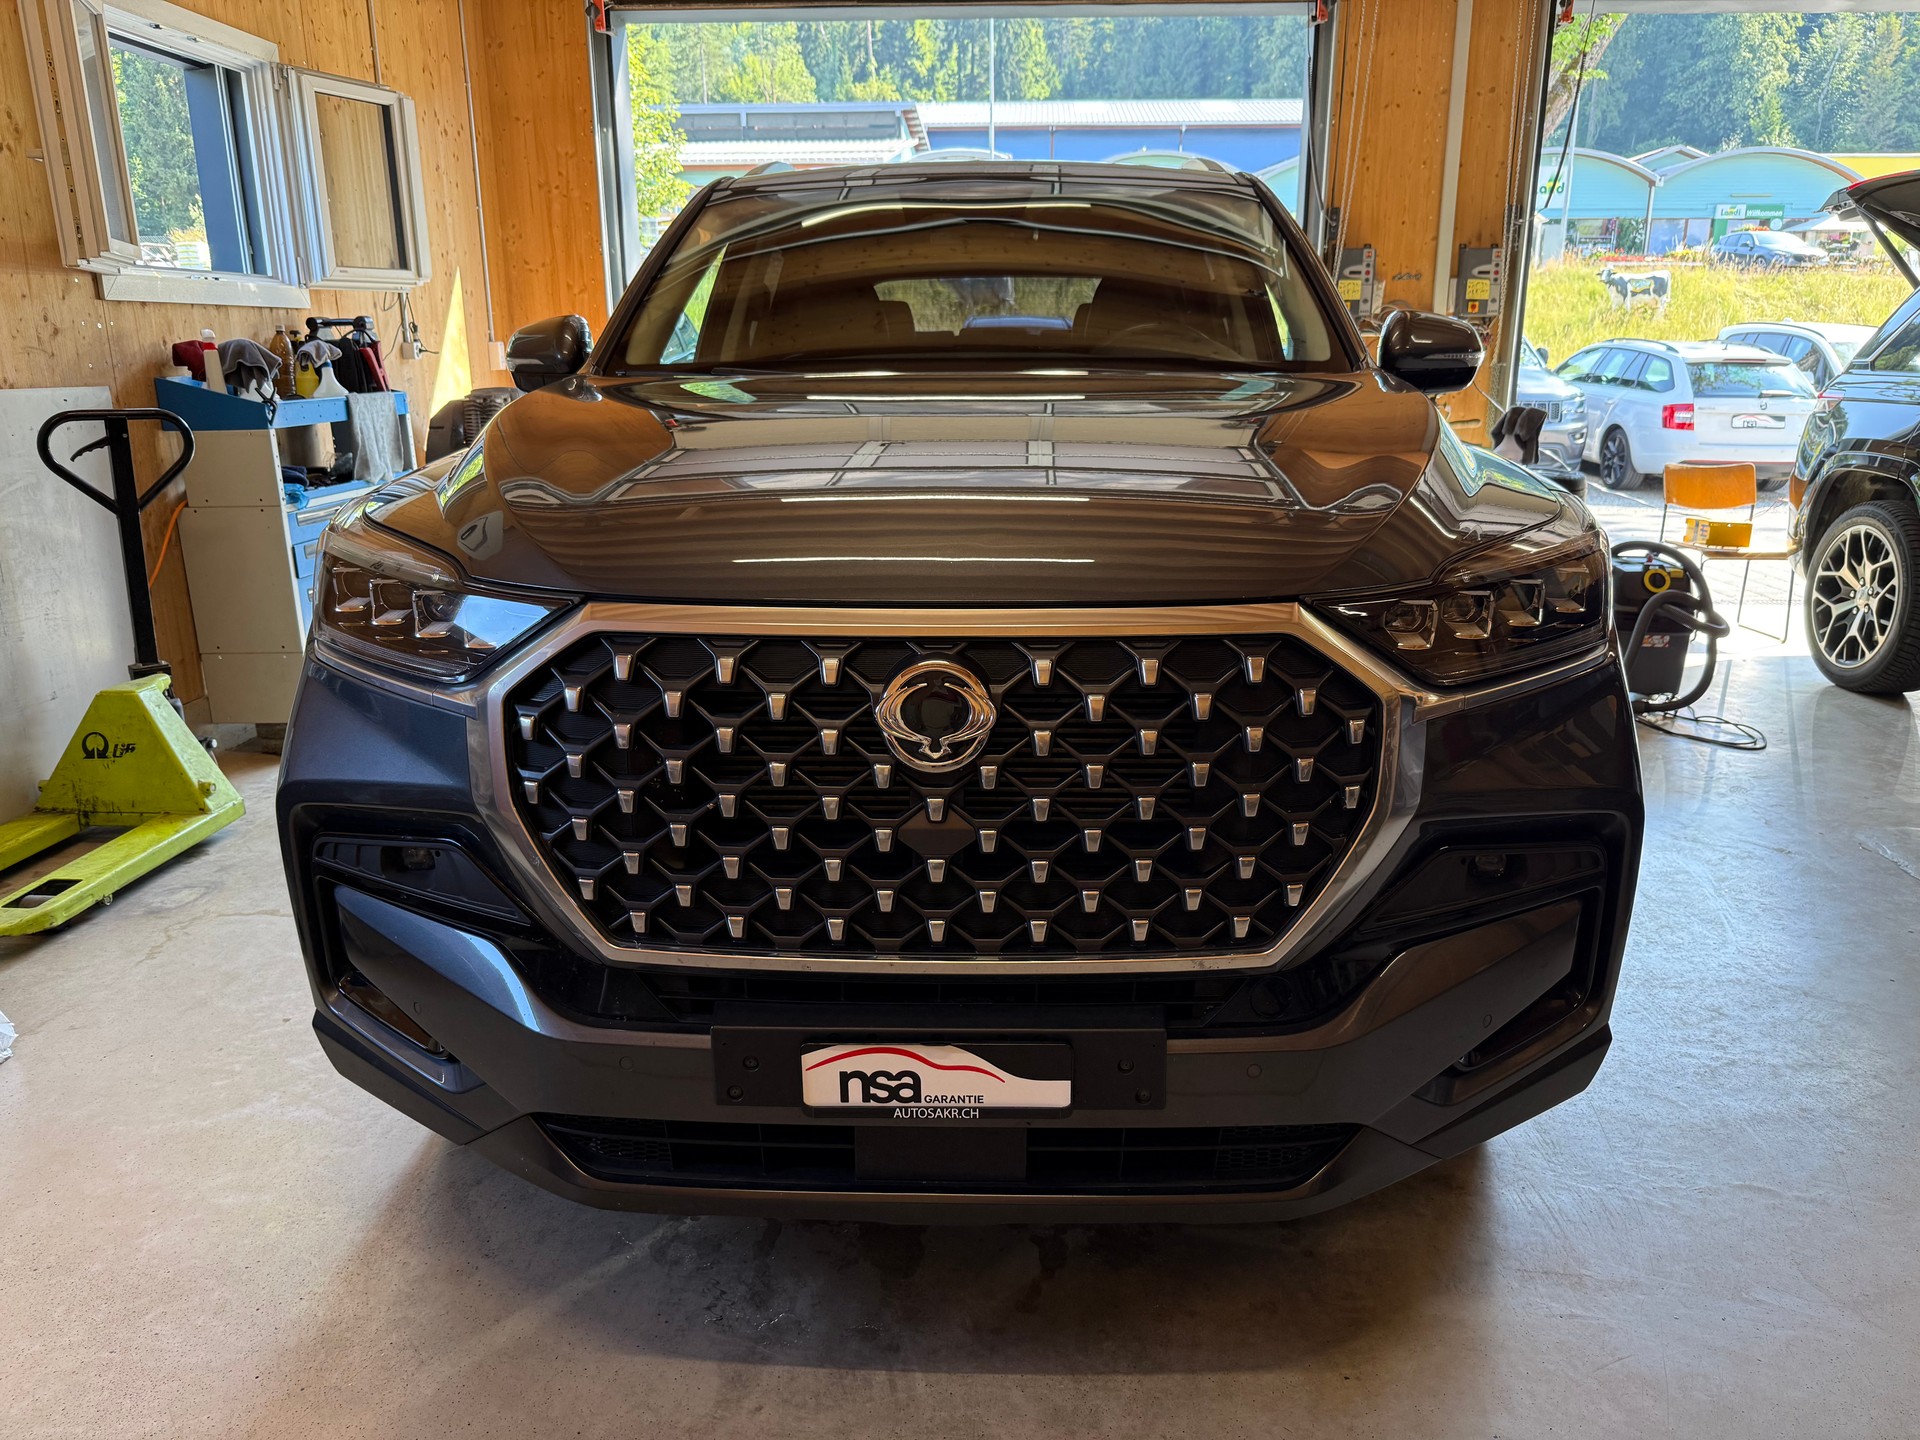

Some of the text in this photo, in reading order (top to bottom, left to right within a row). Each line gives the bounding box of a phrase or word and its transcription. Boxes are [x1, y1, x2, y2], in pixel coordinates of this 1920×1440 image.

[839, 1070, 985, 1104] nsa GARANTIE
[893, 1107, 980, 1119] AUTOSAKR.CH
